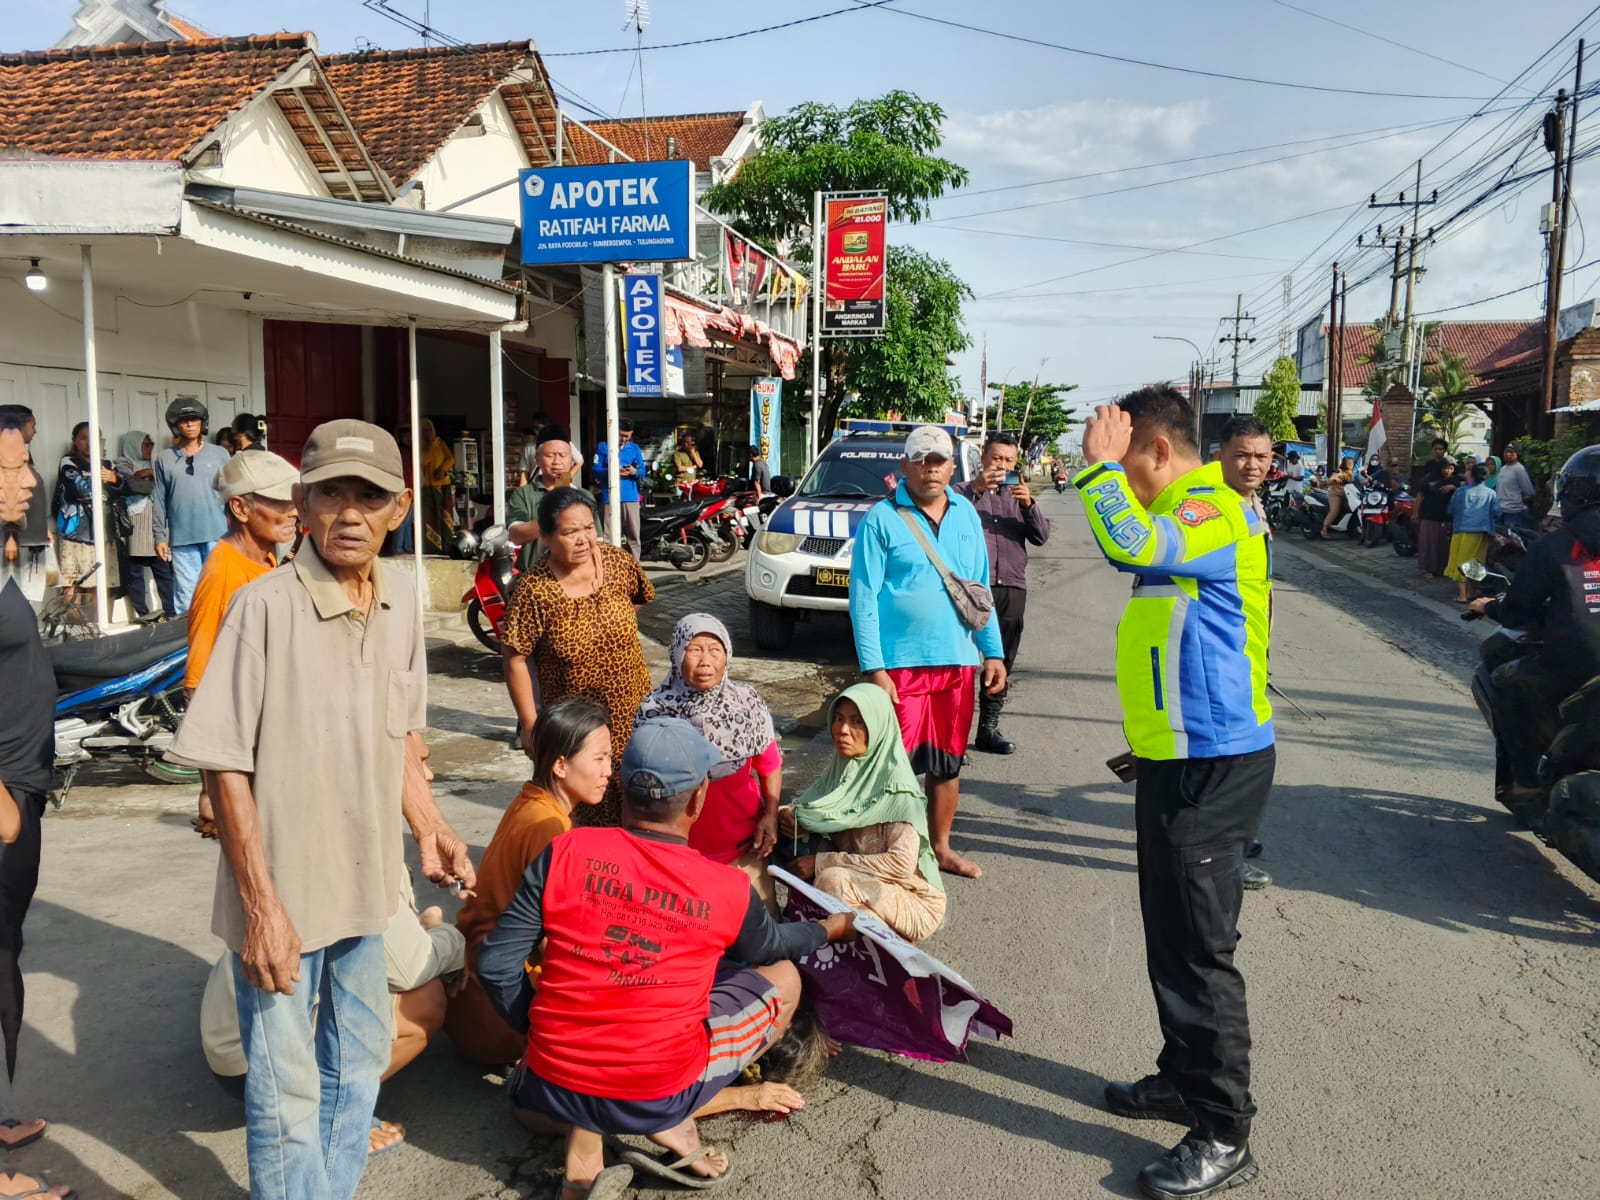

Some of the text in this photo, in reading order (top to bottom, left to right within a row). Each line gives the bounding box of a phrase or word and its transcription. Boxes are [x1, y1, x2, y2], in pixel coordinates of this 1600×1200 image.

[550, 177, 659, 210] APOTEK
[539, 214, 670, 237] RATIFAH FARMA
[592, 239, 633, 247] SUMBERGEMPOL
[831, 255, 880, 265] ANDALAN
[841, 263, 870, 271] BARU
[834, 312, 875, 320] ANGKRINGAN
[630, 279, 656, 383] APOTEK
[756, 383, 775, 394] BUKA
[762, 397, 770, 434] CUCI
[760, 437, 769, 463] MOT
[840, 451, 877, 459] POLRES
[1087, 479, 1152, 557] POLISI
[586, 858, 620, 875] TOKO
[584, 873, 712, 921] TIGA PILAR
